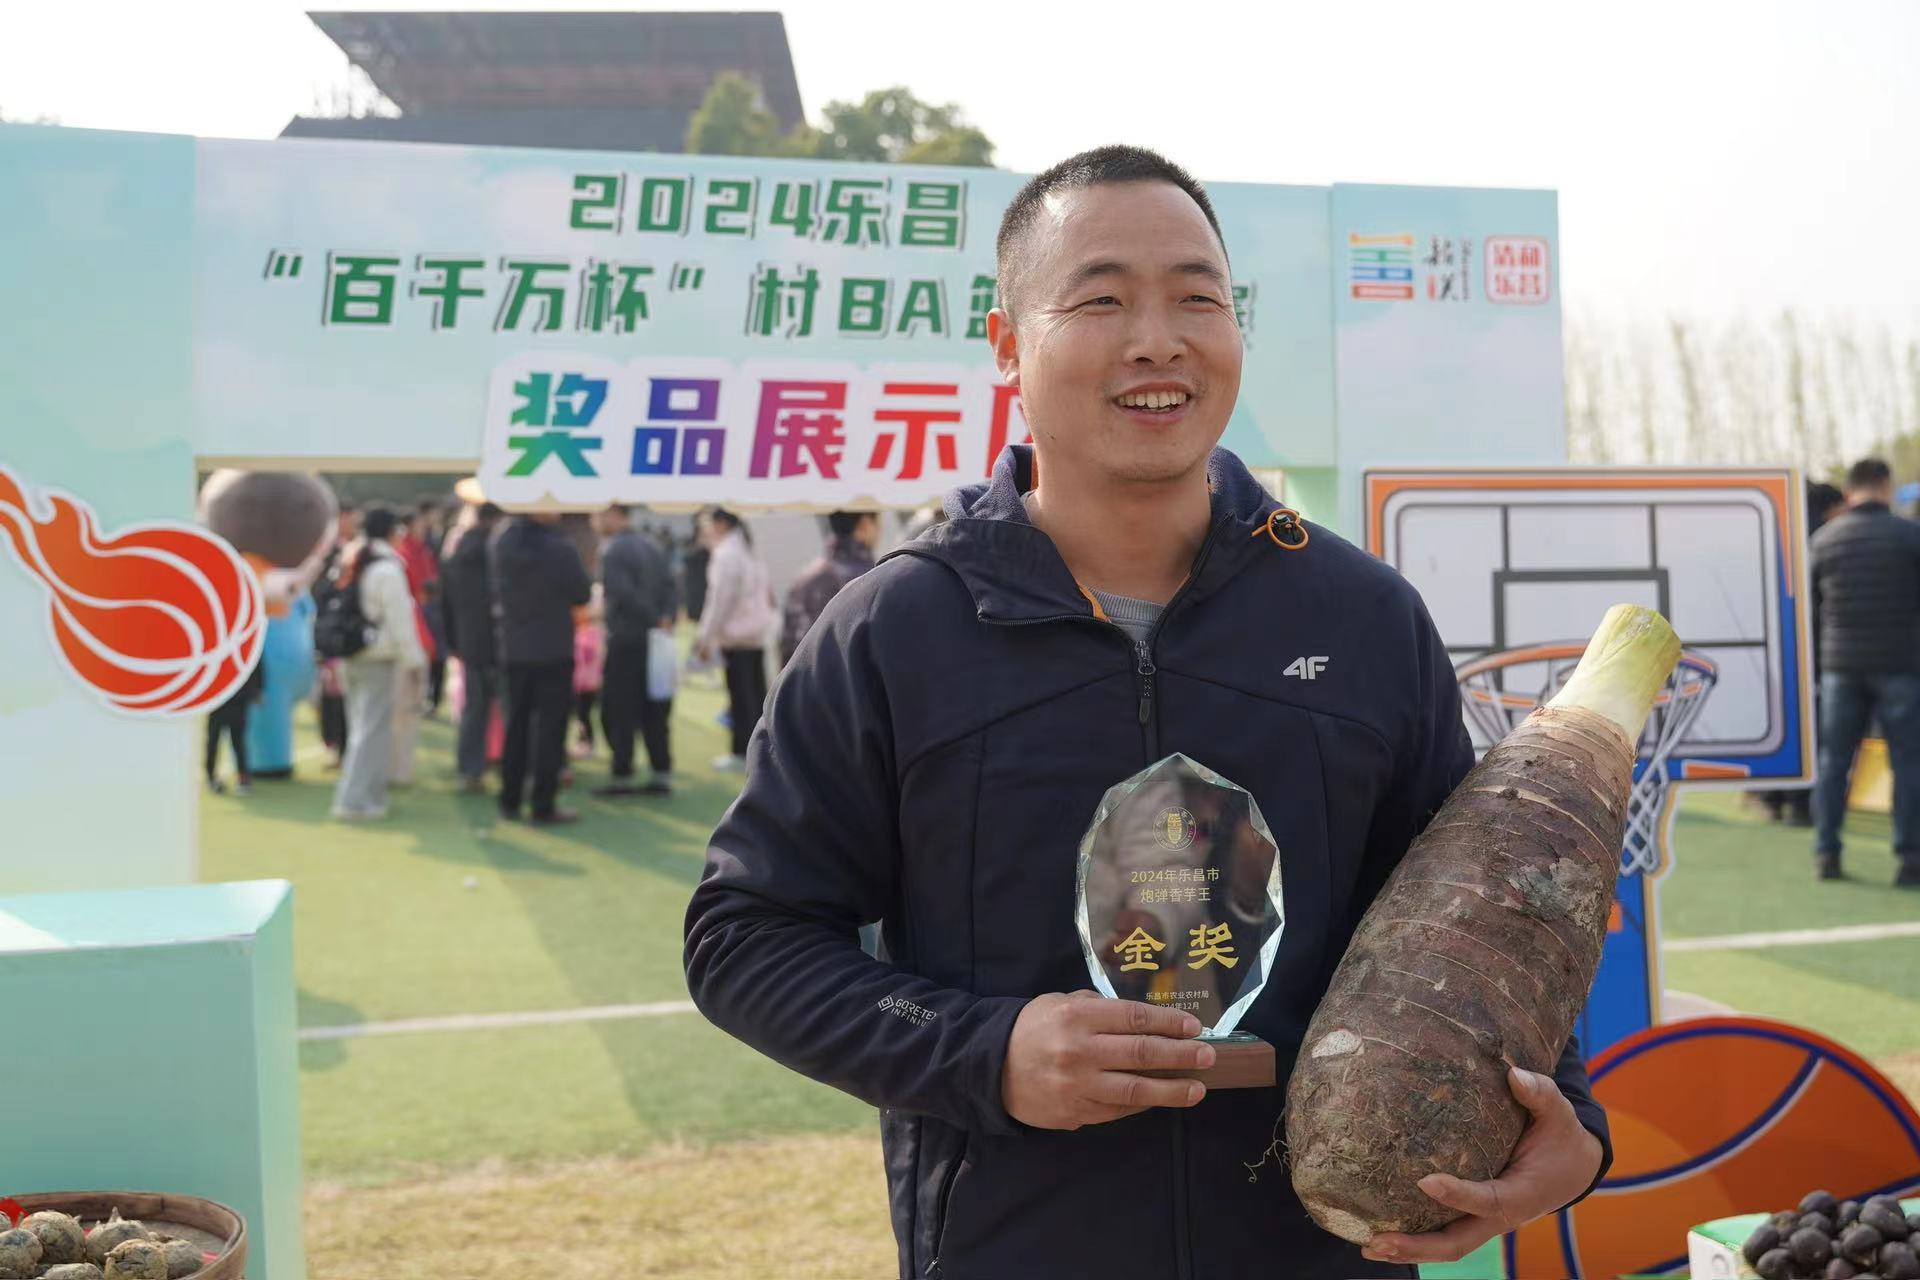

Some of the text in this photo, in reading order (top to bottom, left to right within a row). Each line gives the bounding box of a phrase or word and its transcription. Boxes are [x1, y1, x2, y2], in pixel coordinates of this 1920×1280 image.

[570, 173, 965, 248] 2024乐昌
[504, 371, 1035, 481] 奖品展示
[1282, 655, 1330, 680] 4F
[1131, 867, 1220, 883] 2024年乐昌市
[1141, 887, 1212, 903] 炮弹香芋王
[1145, 990, 1209, 1001] 乐昌市农业农村局
